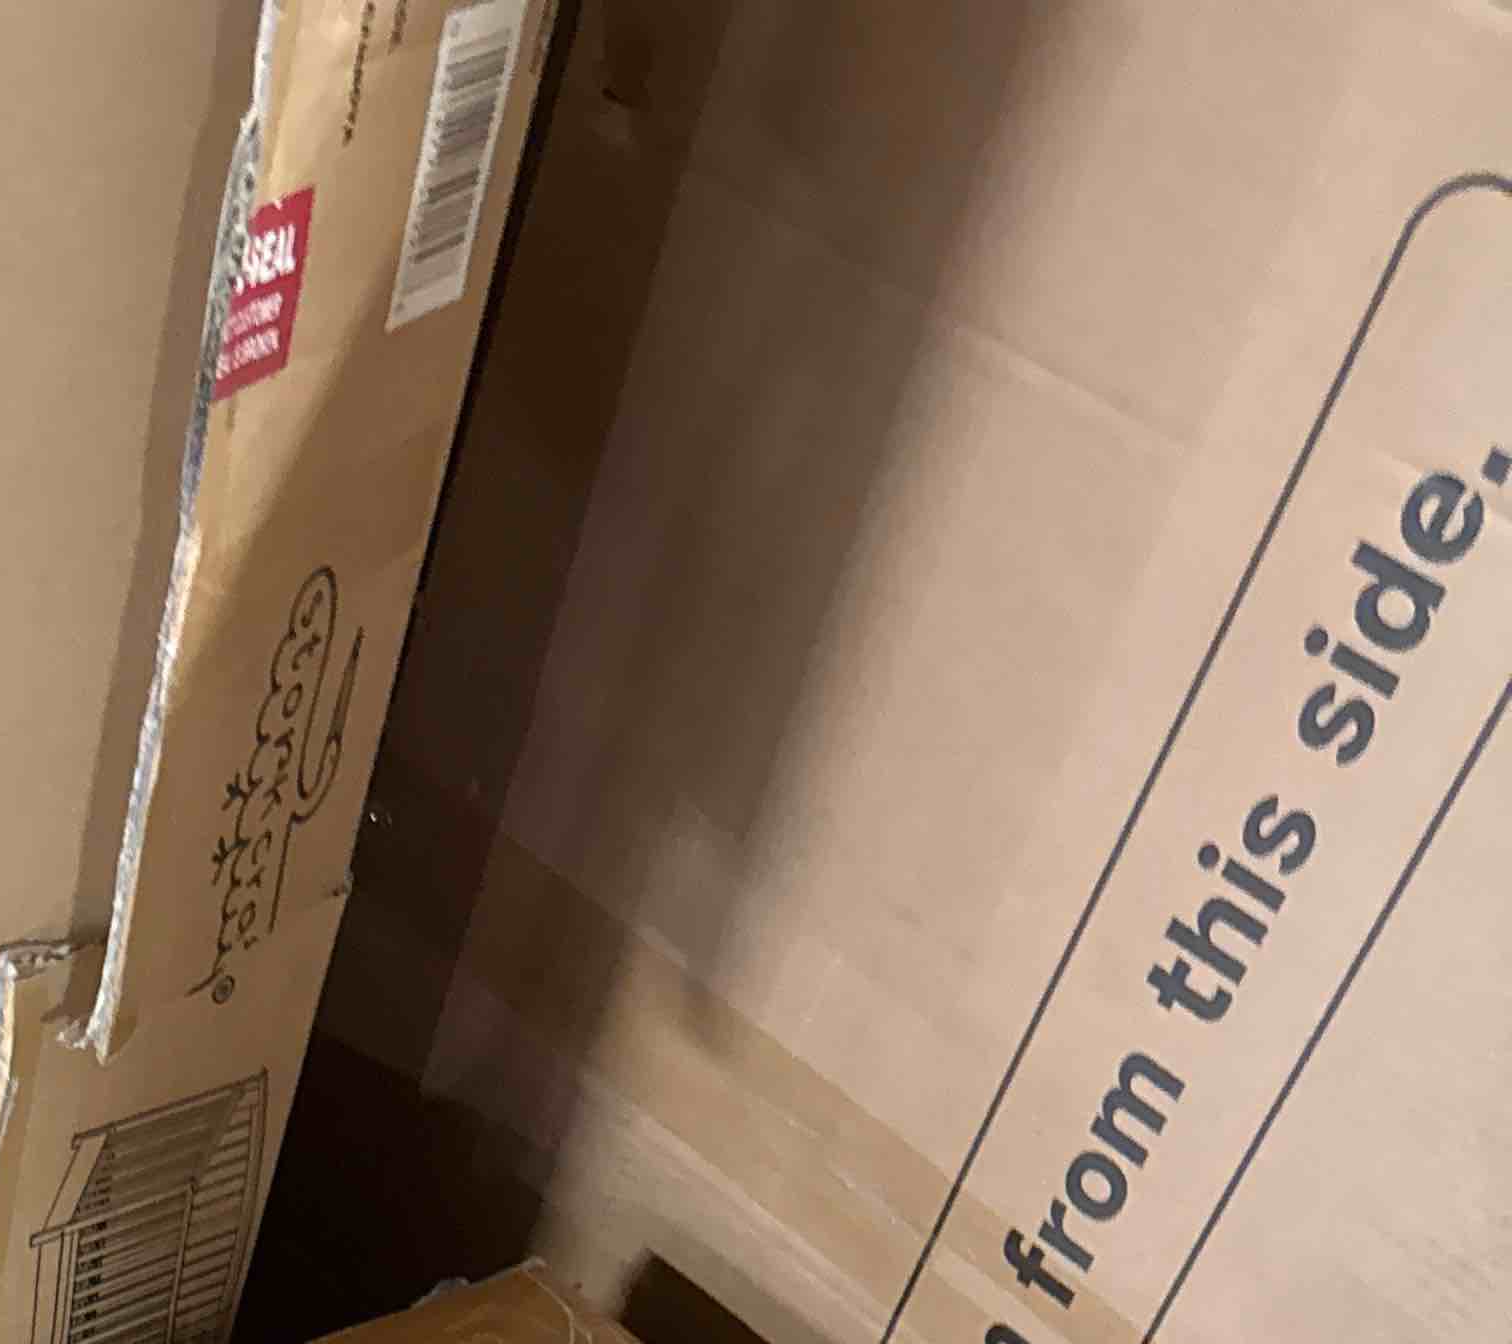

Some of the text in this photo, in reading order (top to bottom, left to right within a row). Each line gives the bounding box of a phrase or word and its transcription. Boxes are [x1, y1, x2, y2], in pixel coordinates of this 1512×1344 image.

[1002, 1049, 1187, 1311] from
[1145, 790, 1319, 1025] this
[1297, 445, 1512, 768] side.
